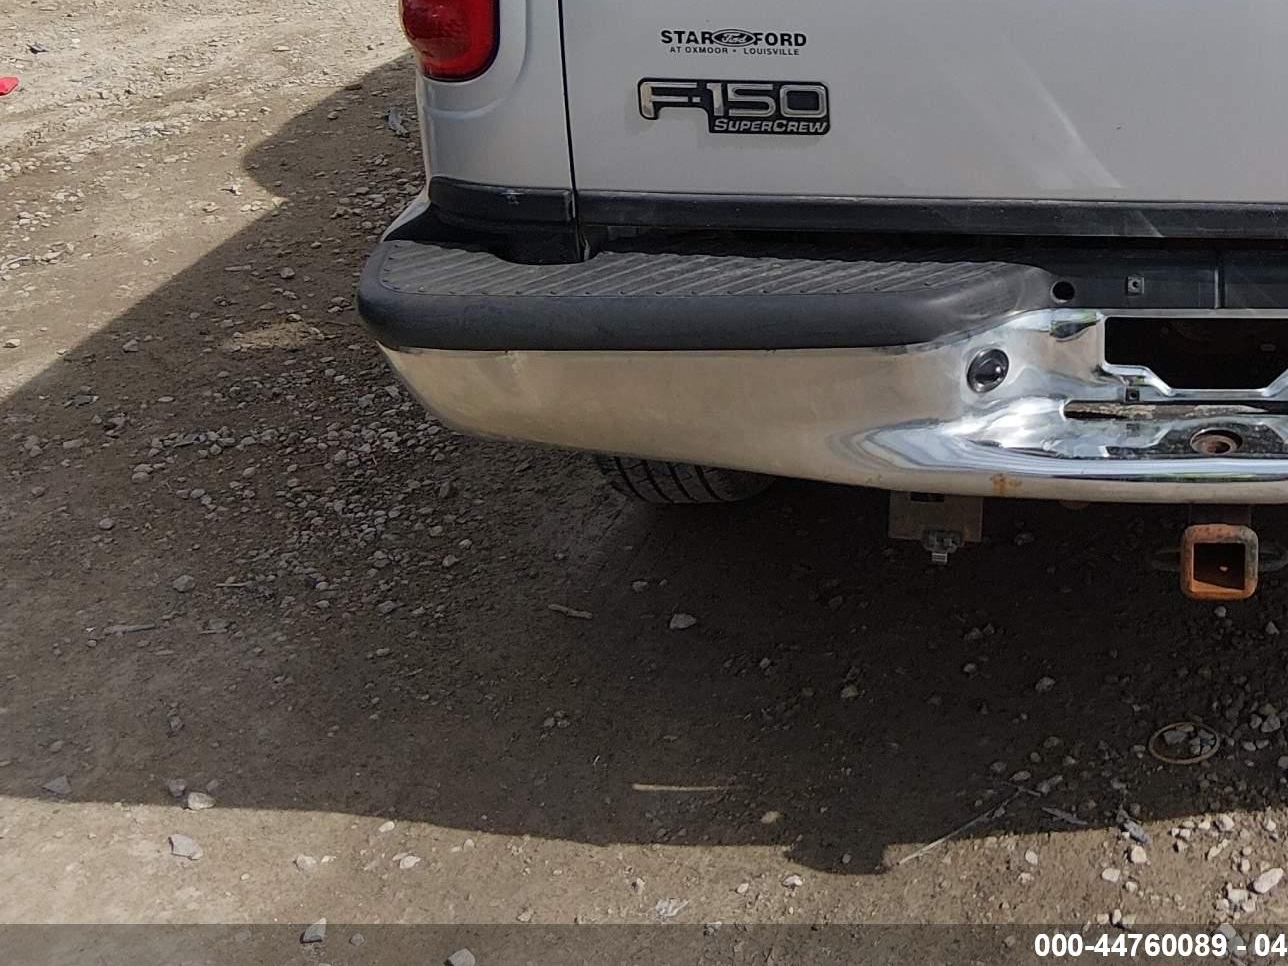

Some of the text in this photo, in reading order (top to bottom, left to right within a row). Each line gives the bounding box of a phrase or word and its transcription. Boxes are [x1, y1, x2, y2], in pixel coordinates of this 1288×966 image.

[661, 30, 713, 45] STAR
[754, 32, 807, 47] FORD
[669, 46, 801, 56] AT OXMOOR LOUISVILLE
[639, 81, 828, 118] F-150
